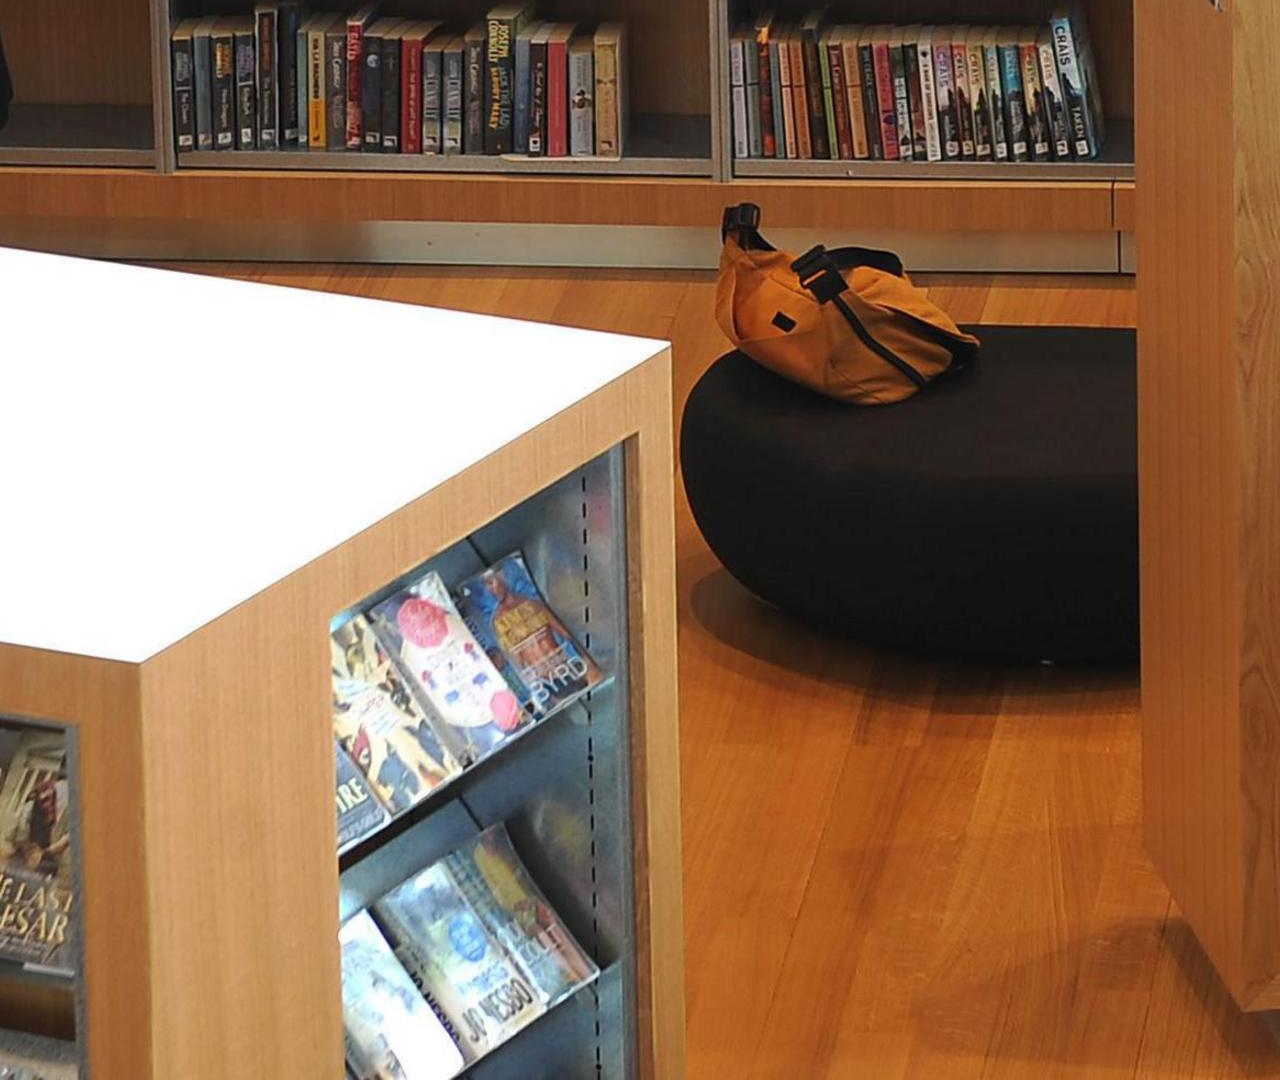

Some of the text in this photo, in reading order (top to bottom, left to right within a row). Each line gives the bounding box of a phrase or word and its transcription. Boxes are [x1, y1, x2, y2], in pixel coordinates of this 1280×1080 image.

[1056, 26, 1071, 66] CRAIS
[1071, 106, 1084, 138] TAKEN
[530, 655, 589, 705] BYRD
[14, 882, 75, 913] LAST
